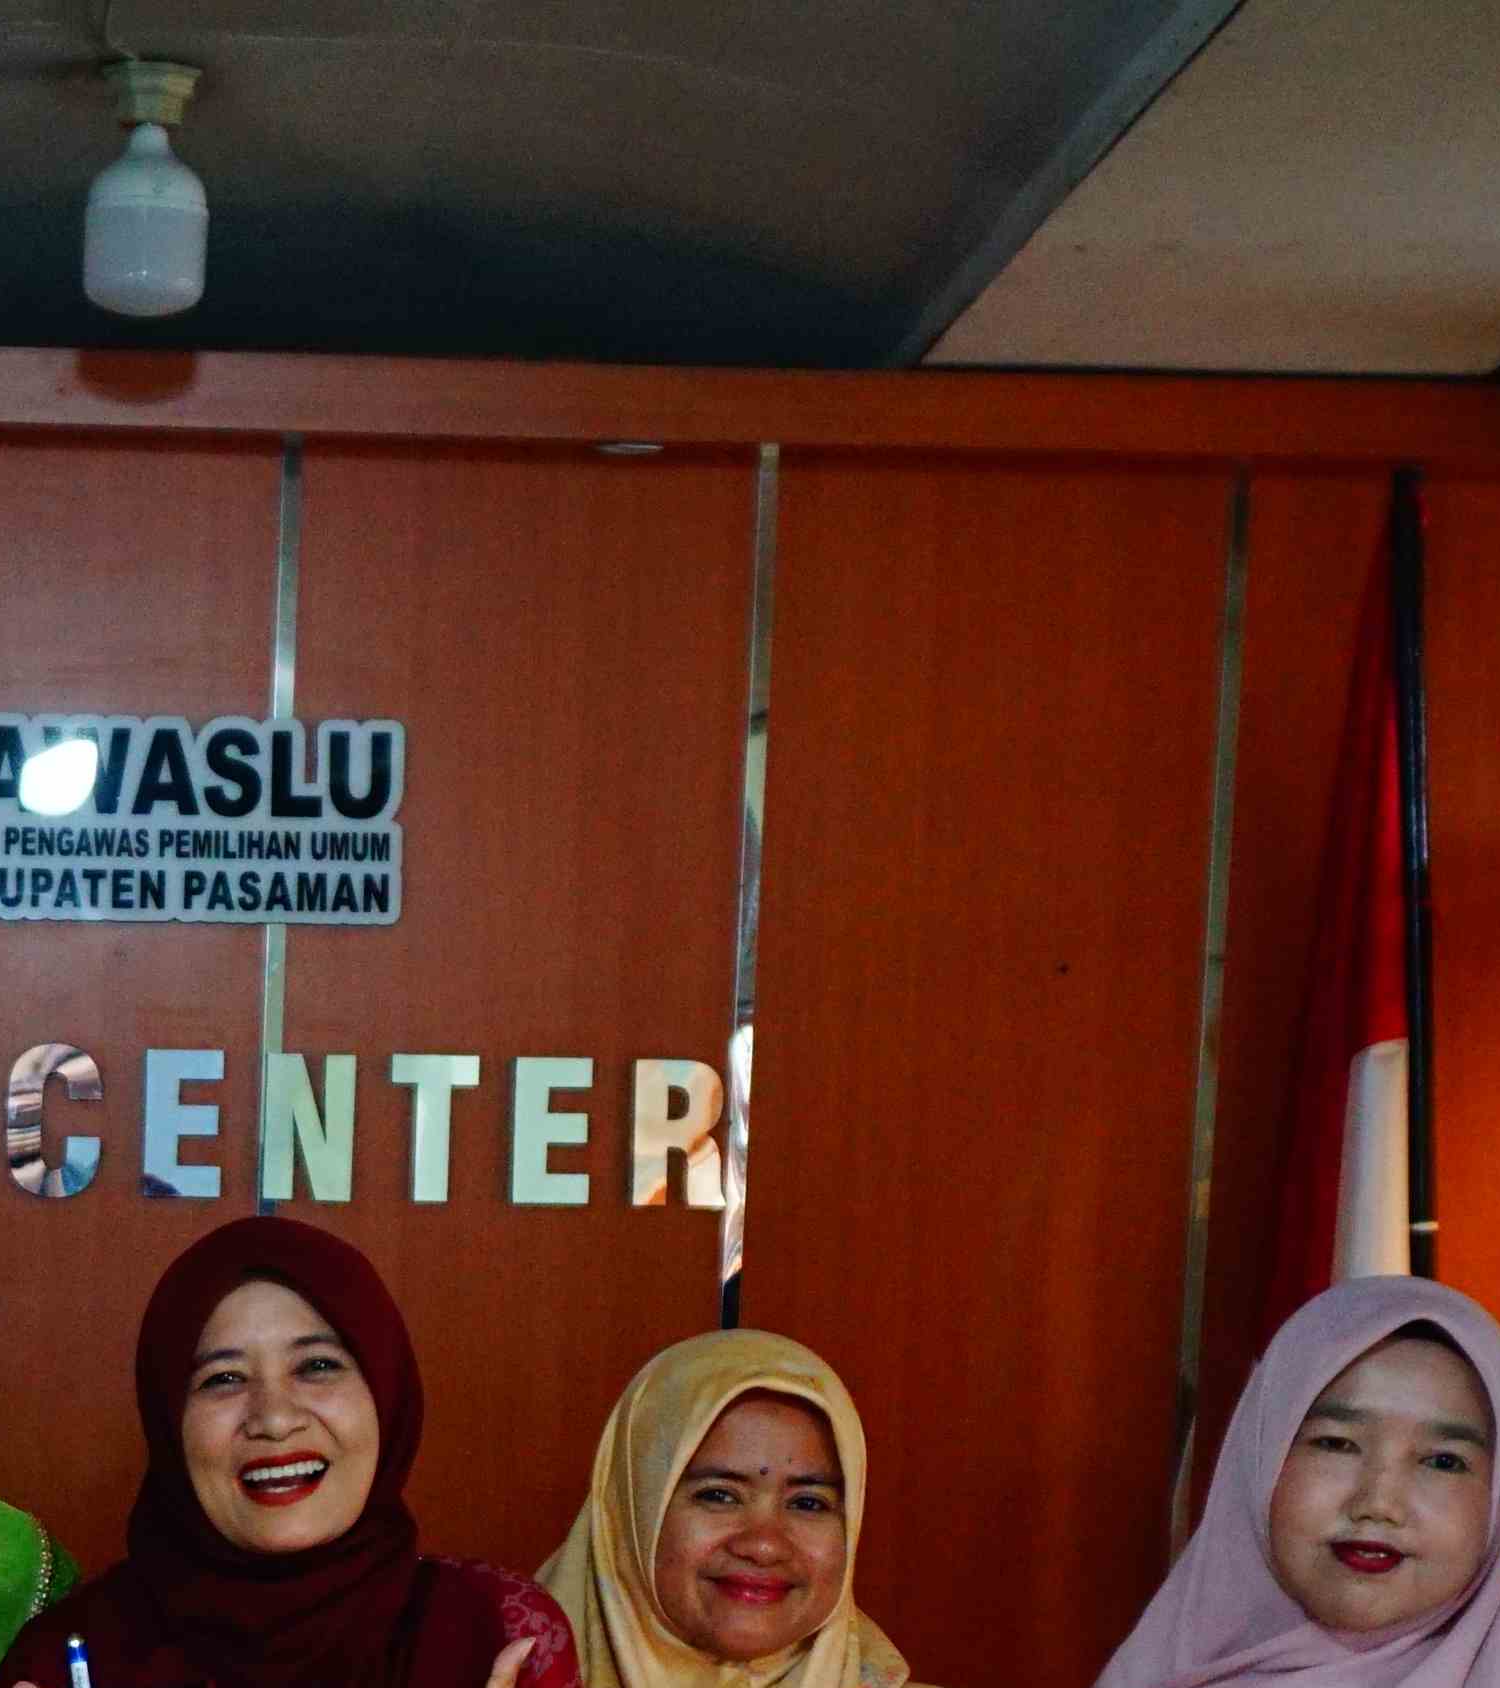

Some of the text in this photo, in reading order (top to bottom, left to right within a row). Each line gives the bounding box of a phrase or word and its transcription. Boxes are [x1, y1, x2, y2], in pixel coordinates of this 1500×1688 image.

[4, 826, 150, 858] PENGAWAS
[159, 829, 301, 861] PEMILIHAN
[310, 831, 391, 863] UMUM
[183, 870, 390, 913] PASAMAN
[6, 1041, 727, 1210] CENTER
